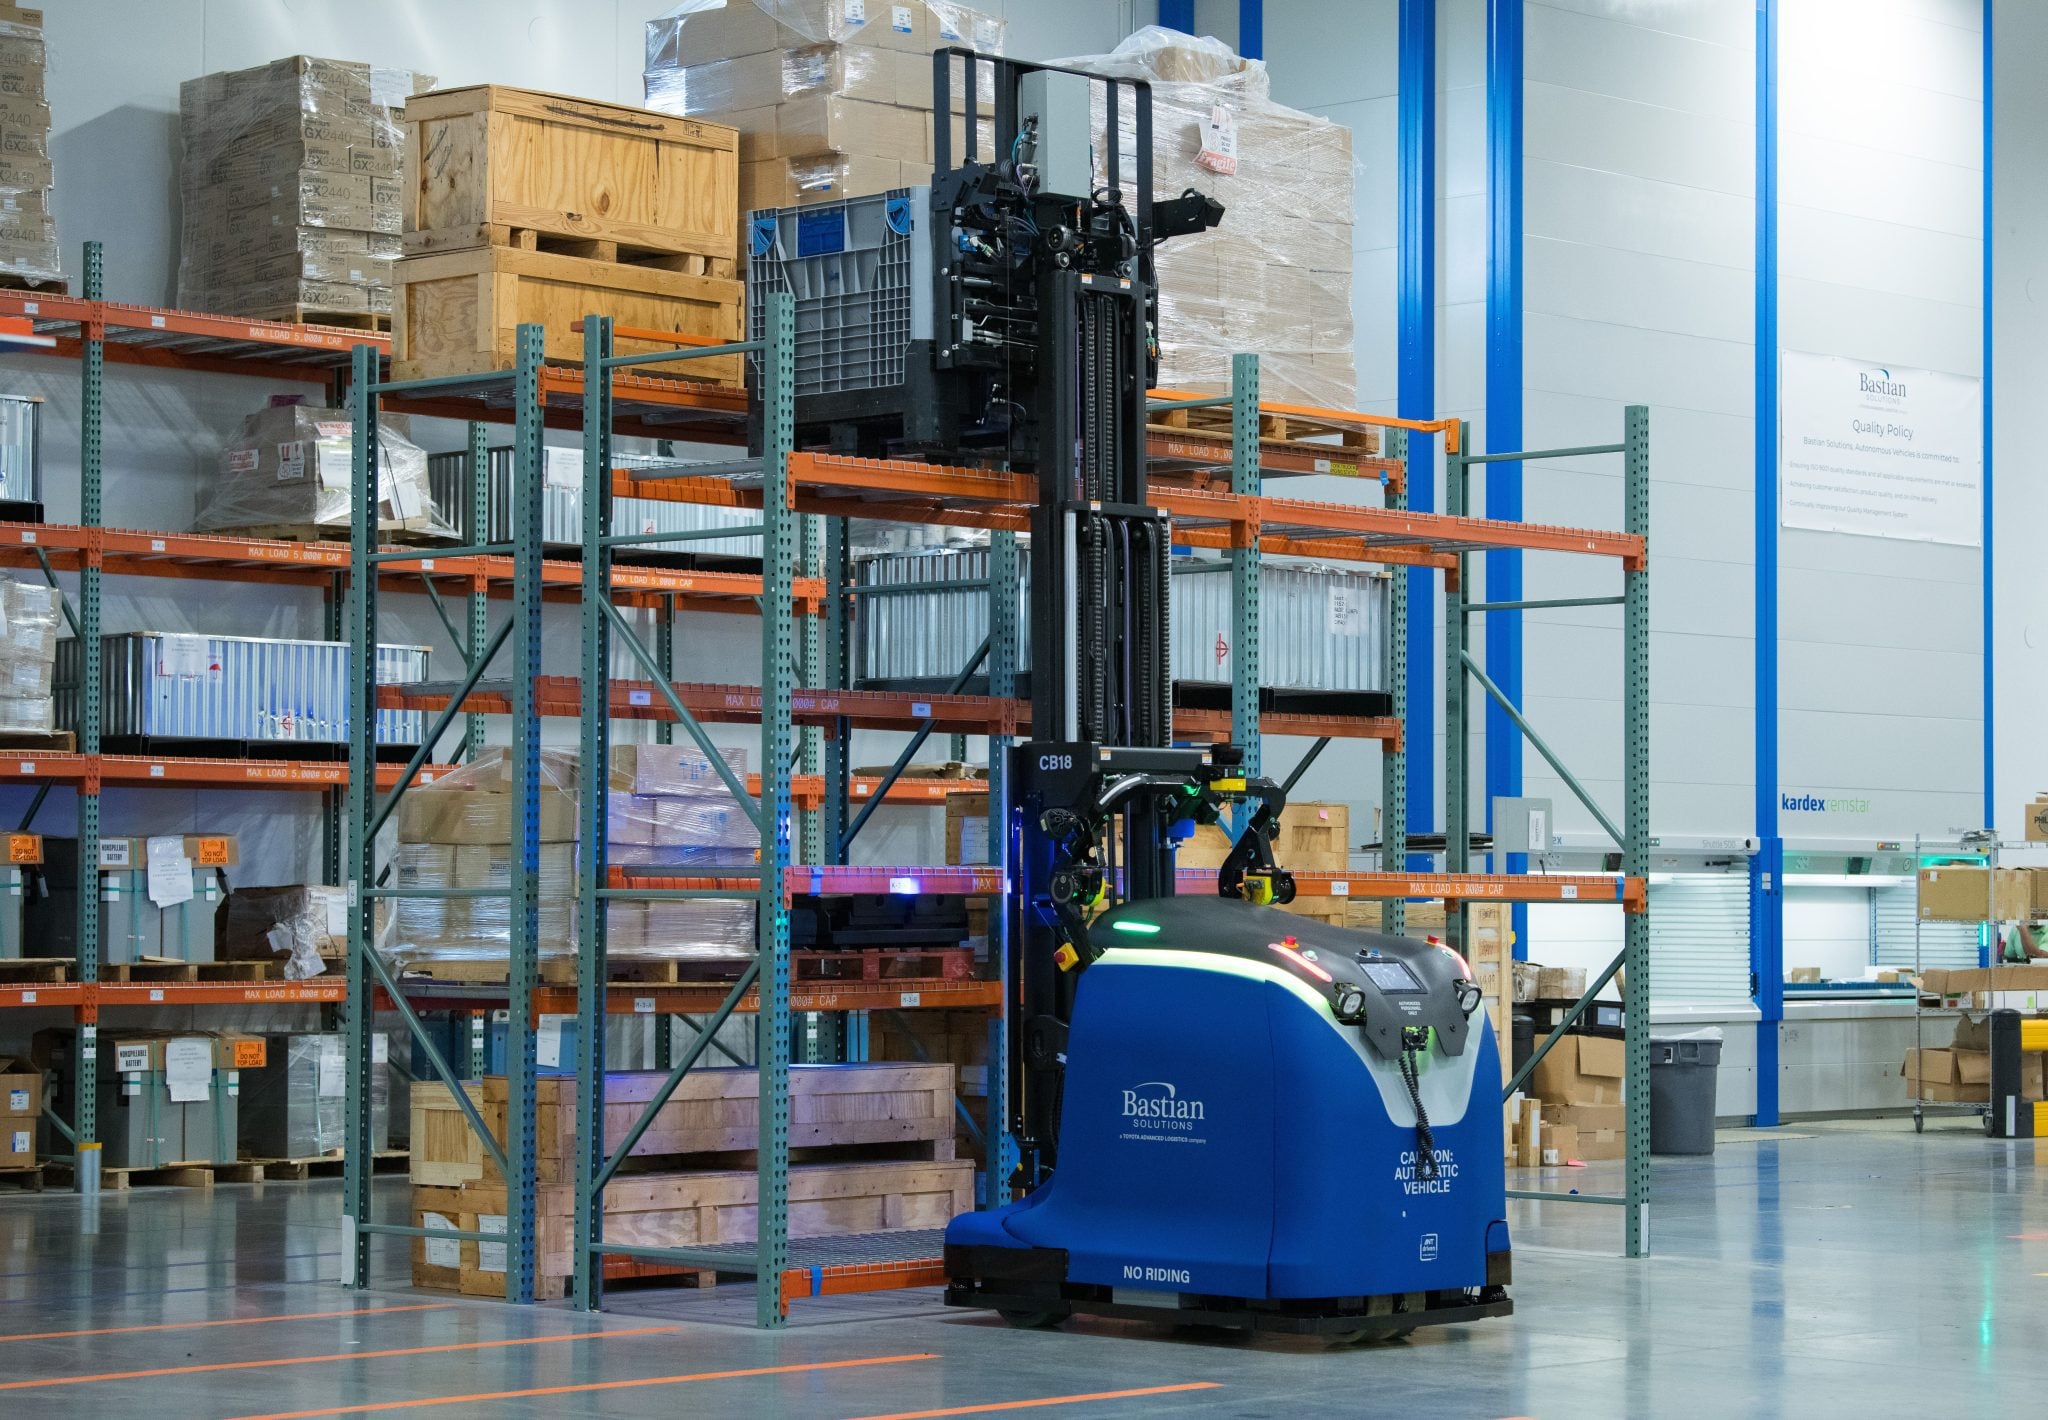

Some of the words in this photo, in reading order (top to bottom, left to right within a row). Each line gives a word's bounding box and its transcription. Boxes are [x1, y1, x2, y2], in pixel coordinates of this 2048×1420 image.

[353, 159, 393, 174] GX2440
[249, 327, 265, 337] MAX
[269, 330, 289, 340] LOAD
[327, 335, 343, 345] CAP
[1860, 372, 1906, 398] Bastian
[1852, 419, 1885, 438] Quality
[1887, 423, 1914, 441] Policy
[1168, 443, 1184, 454] MAX
[1189, 445, 1209, 457] LOAD
[1213, 447, 1233, 460] 5,00
[1803, 436, 1825, 447] Bastian
[1855, 443, 1892, 455] Autonomous
[248, 548, 264, 557] MAX
[269, 550, 289, 559] LOAD
[326, 552, 342, 562] CAP
[612, 574, 626, 584] MAX
[629, 575, 648, 585] LOAD
[679, 578, 693, 588] CAP
[725, 694, 745, 706] MAX
[821, 698, 840, 710] CAP
[1039, 754, 1073, 771] CB18
[246, 768, 262, 777] MAX
[267, 768, 287, 778] LOAD
[324, 770, 340, 779] CAP
[1781, 793, 1825, 812] kardex
[1826, 797, 1872, 813] remstar
[106, 853, 123, 861] BATTERY
[972, 878, 991, 890] MAX
[1410, 882, 1426, 894] MAX
[1430, 883, 1450, 894] LOAD
[1488, 884, 1504, 895] CAP
[244, 989, 260, 999] MAX
[265, 989, 286, 998] LOAD
[323, 989, 338, 998] CAP
[119, 1049, 147, 1058] NONSPILLABLE
[125, 1059, 142, 1068] BATTERY
[1121, 1090, 1205, 1120] Bastian
[1133, 1118, 1193, 1130] SOLUTIONS
[1400, 1149, 1454, 1165] CAON:
[1404, 1180, 1450, 1195] VEHICLE
[1123, 1265, 1143, 1280] NO
[1145, 1267, 1190, 1284] RIDING
